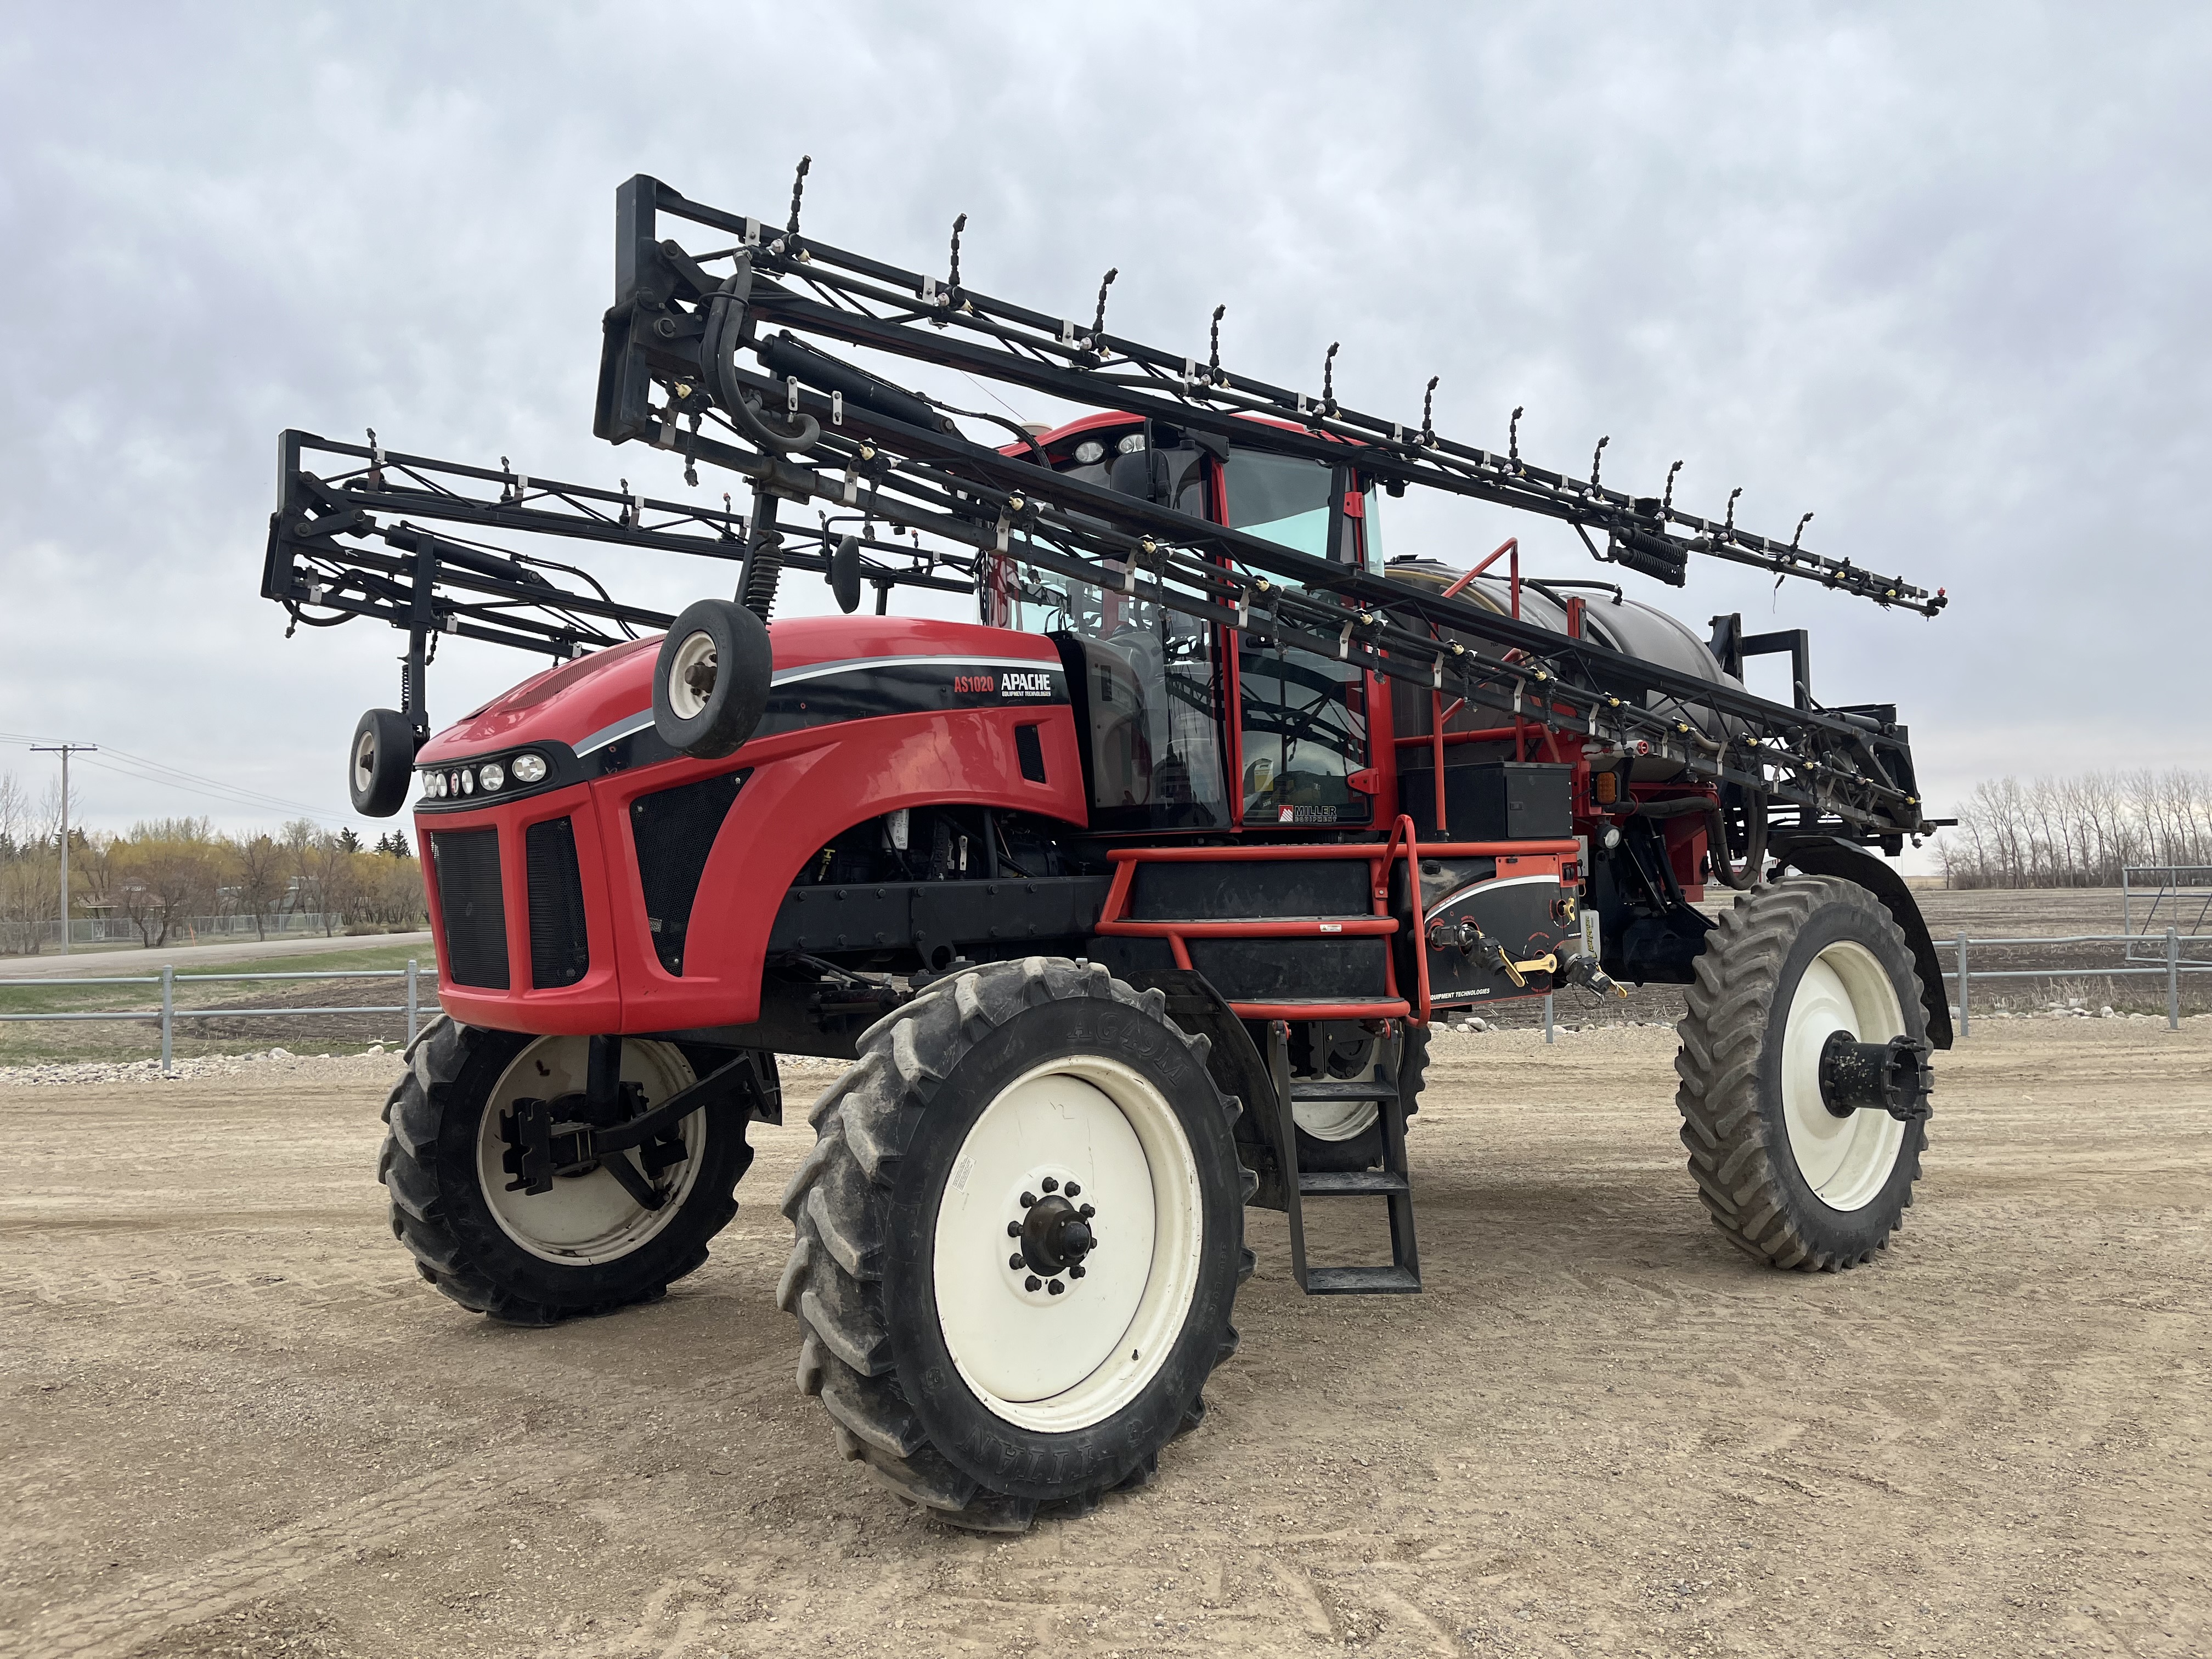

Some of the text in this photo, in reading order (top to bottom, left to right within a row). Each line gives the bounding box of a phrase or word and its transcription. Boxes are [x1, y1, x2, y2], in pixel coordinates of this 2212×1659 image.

[954, 676, 994, 692] AS1020
[1001, 674, 1051, 691] APACHE
[1295, 806, 1337, 817] MILLER
[1430, 988, 1490, 1001] QUIPMENT TECHNOLOGIES
[1066, 1008, 1189, 1087] AG49M
[955, 1426, 1096, 1484] TITAN
